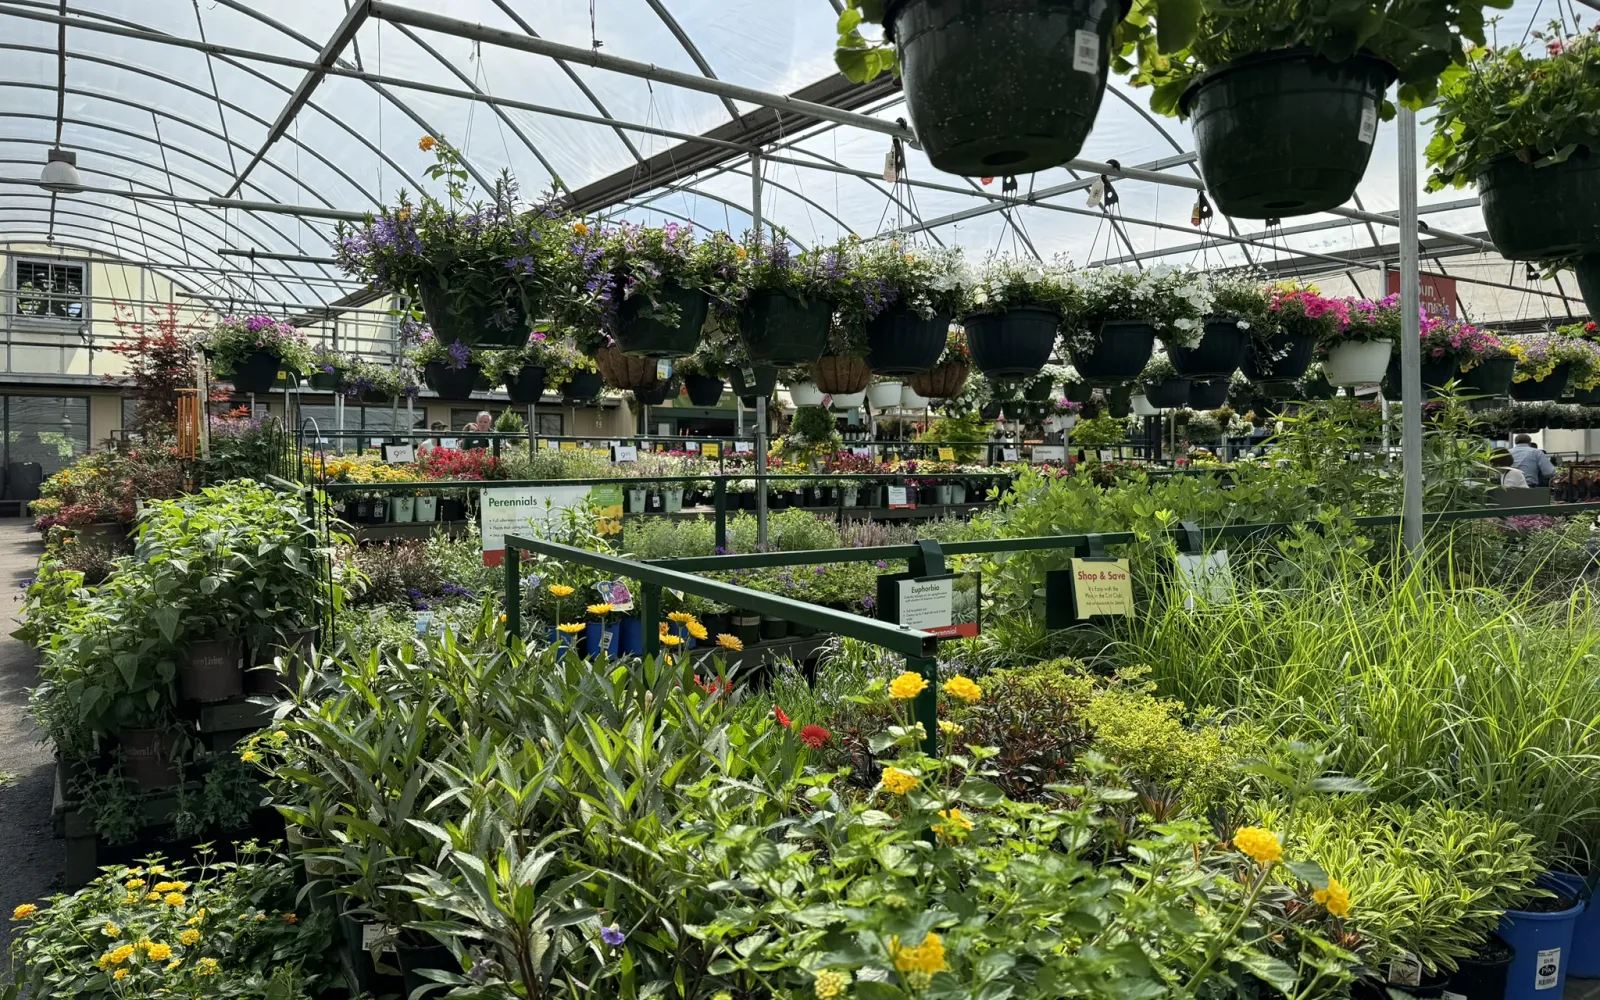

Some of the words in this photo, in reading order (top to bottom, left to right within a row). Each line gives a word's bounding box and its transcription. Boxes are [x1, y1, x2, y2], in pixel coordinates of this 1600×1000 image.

[488, 496, 538, 507] Perennials
[1078, 570, 1097, 582] Shop
[1100, 571, 1106, 580] &
[1108, 571, 1126, 580] Save
[912, 584, 940, 594] Euphorbia
